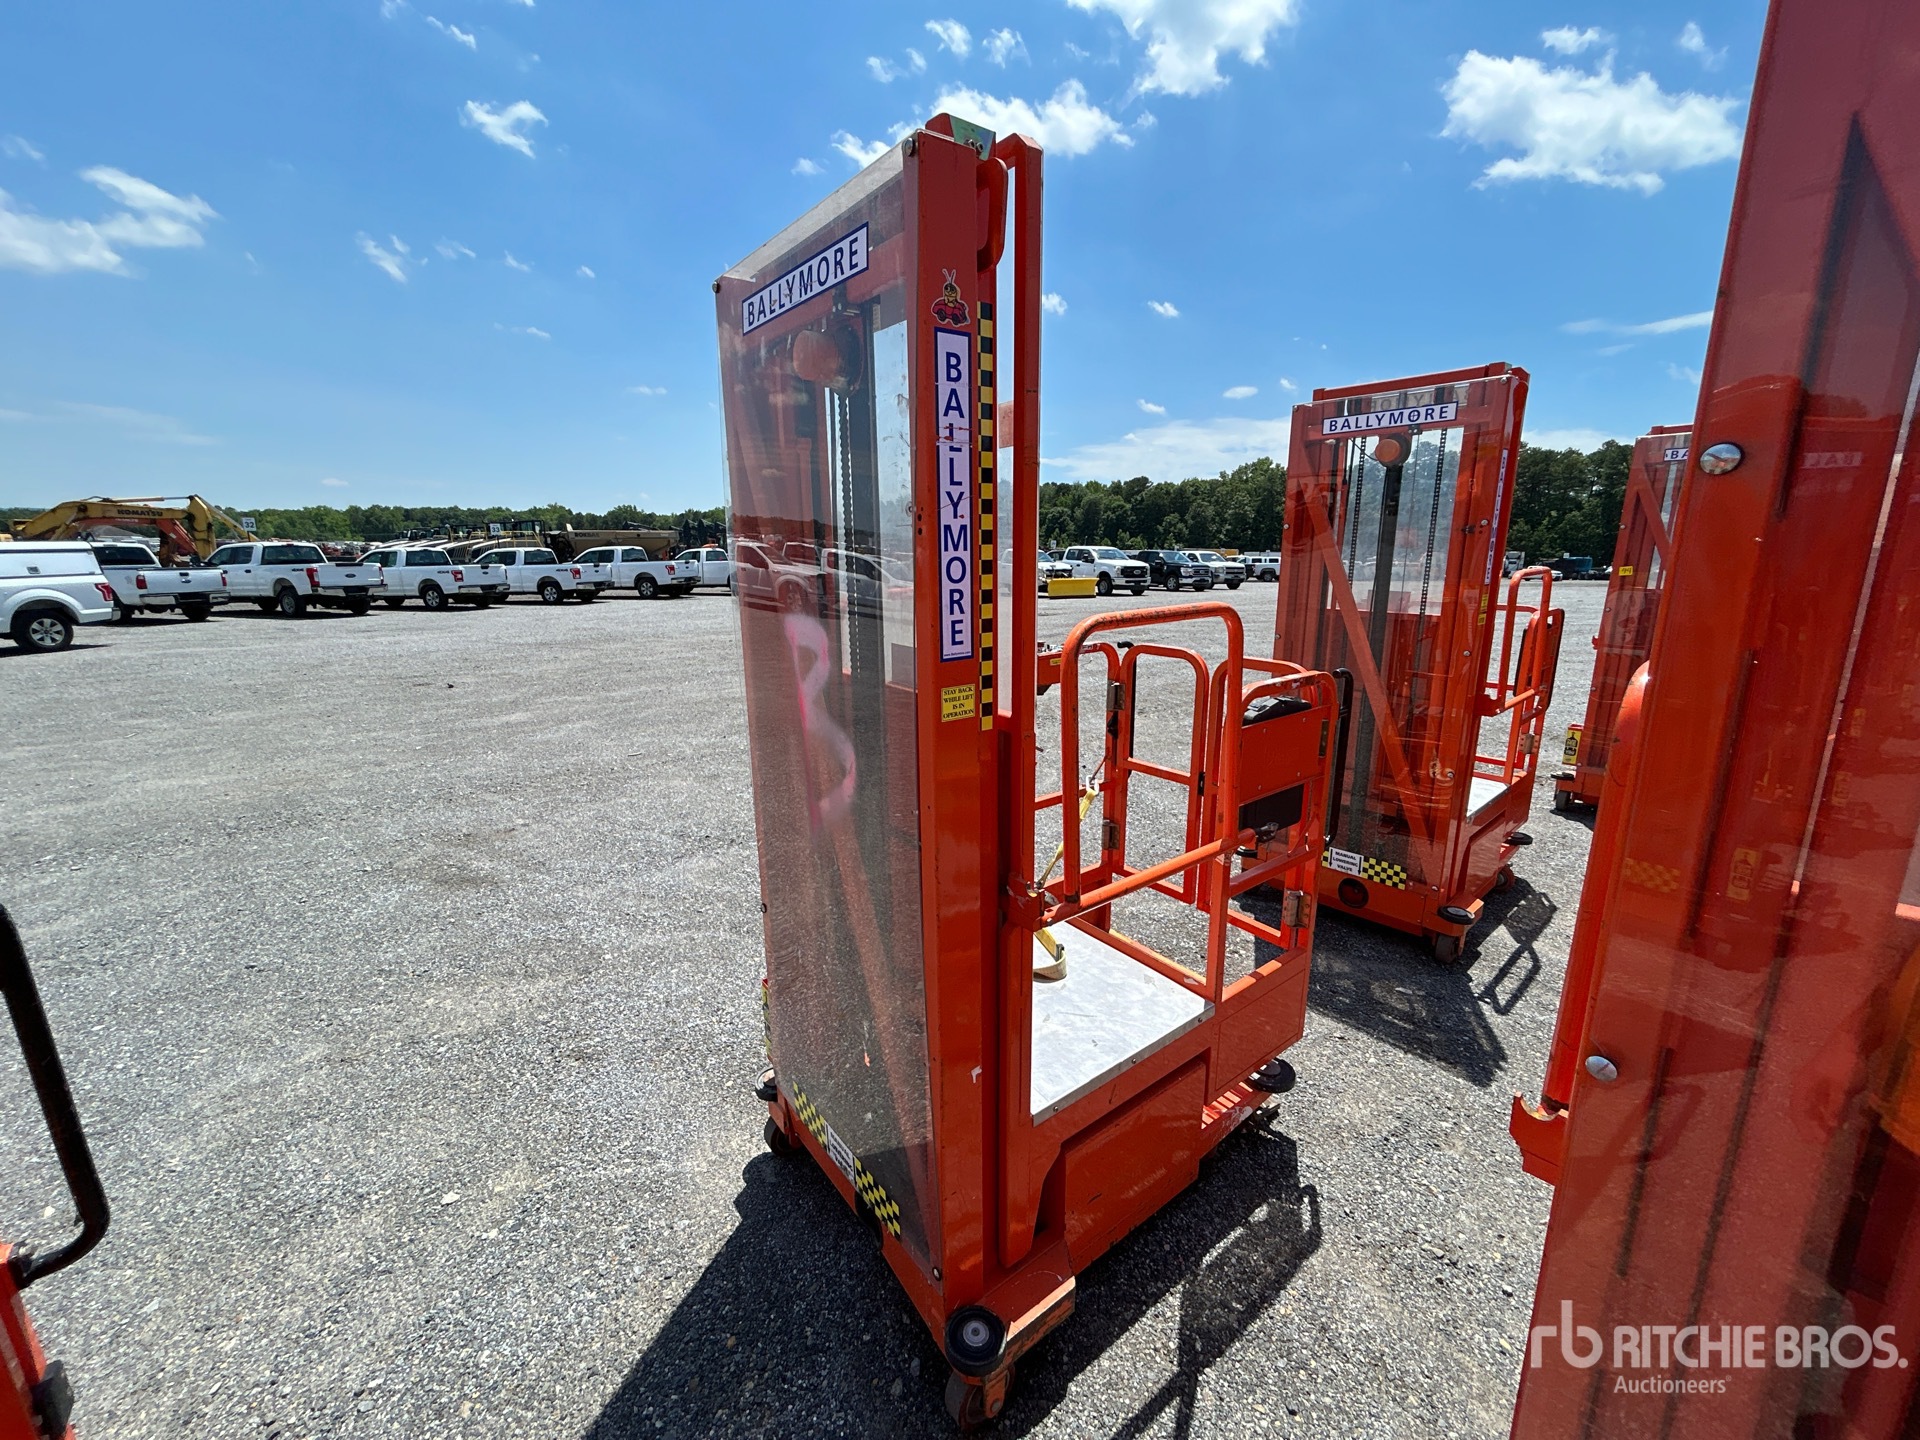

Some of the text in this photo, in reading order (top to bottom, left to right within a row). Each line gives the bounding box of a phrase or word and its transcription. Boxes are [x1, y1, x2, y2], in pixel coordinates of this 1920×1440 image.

[747, 236, 859, 327] BALLYMORE
[1329, 406, 1449, 432] BALLYMORE
[943, 351, 968, 646] BALLYMORE
[117, 508, 164, 517] KOMATSU
[245, 521, 255, 529] 32
[943, 709, 974, 718] OPERATION
[1335, 851, 1357, 861] MANUAL
[1332, 856, 1359, 868] LOWERING
